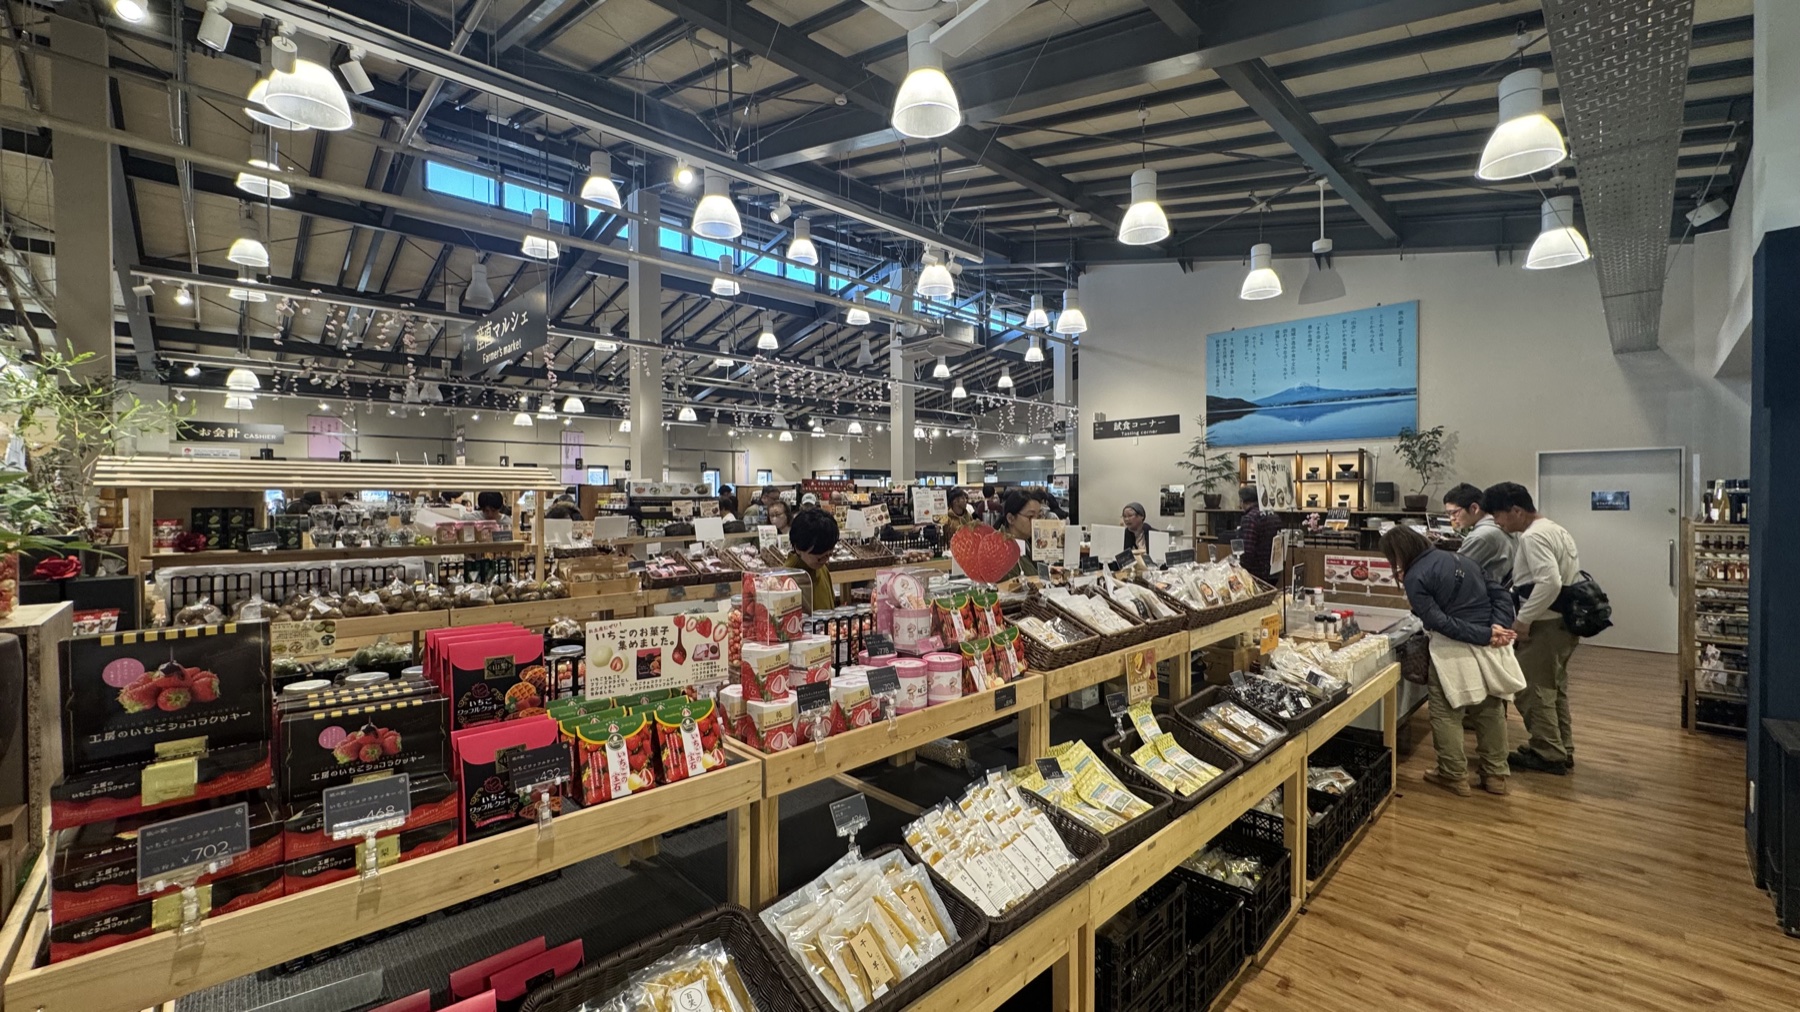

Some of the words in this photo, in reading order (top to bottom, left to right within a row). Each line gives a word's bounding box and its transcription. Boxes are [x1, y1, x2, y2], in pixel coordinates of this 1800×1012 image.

[475, 311, 529, 352] 産直マルシェ
[482, 346, 503, 364] Farmer's
[503, 338, 522, 354] market
[200, 427, 241, 439] お会計
[243, 432, 277, 440] CASHIER
[1113, 419, 1166, 432] 試食コーナー
[500, 458, 506, 466] 4
[576, 460, 581, 468] 5
[595, 626, 669, 641] いちごのお菓子
[617, 637, 675, 651] 集めました。
[457, 703, 504, 716] ワッフルクッキー
[468, 696, 493, 707] いちご
[89, 711, 252, 745] 工房のいちごショコラクッキー
[691, 733, 702, 763] いちごの
[310, 754, 425, 782] 工房のいちごショコラクッキー
[617, 751, 628, 784] いちごの
[688, 752, 698, 771] 宝石
[535, 767, 561, 783] ¥432
[612, 772, 622, 792] 宝石
[71, 781, 136, 799] いちごショコラクッキー
[92, 780, 114, 790] 工房の
[469, 796, 518, 814] ワッフルクッキー
[481, 790, 507, 804] いちご
[145, 823, 231, 851] いちごショコラクッキー
[181, 840, 229, 864] ¥702
[317, 856, 335, 866] 工房の
[96, 866, 120, 878] 工房の
[301, 857, 352, 875] いちごショコラクッキー
[74, 867, 137, 888] いちごショコラクッキ
[910, 895, 927, 925] 干し芋
[72, 915, 142, 940] いちごショコラクッキー
[95, 915, 119, 928] 工房の
[860, 938, 879, 971] 干し芋
